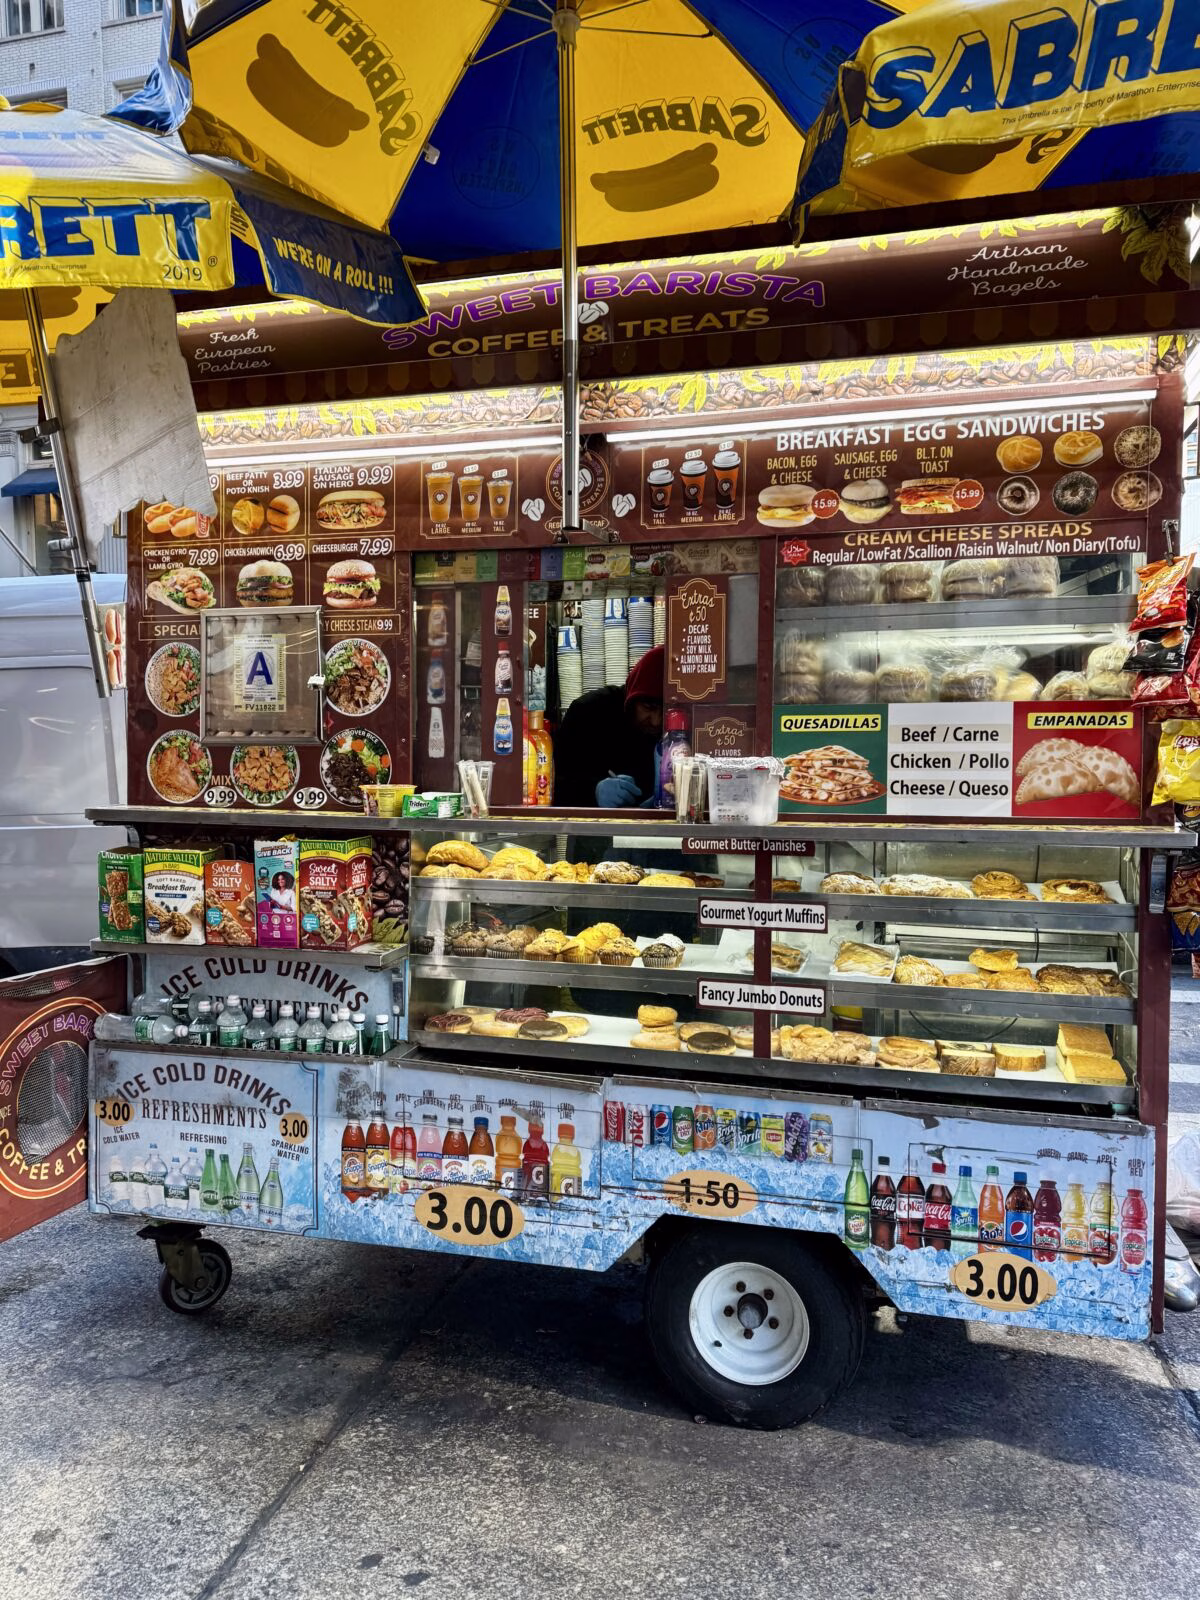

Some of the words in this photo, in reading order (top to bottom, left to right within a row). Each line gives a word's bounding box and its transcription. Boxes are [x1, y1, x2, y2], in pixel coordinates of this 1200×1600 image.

[966, 242, 1068, 262] Artisan
[272, 236, 314, 270] WE'RE
[316, 255, 331, 275] ON
[334, 261, 342, 282] A
[346, 266, 376, 292] ROLL
[947, 255, 1089, 281] Handmade
[163, 264, 202, 282] 2019
[971, 277, 1062, 297] Bagels
[382, 281, 564, 350] SWEET
[583, 270, 827, 308] BARISTA
[209, 327, 260, 344] Fresh
[427, 331, 564, 358] COFFEE
[583, 324, 608, 343] &
[618, 307, 770, 339] TREATS
[195, 344, 276, 361] European
[198, 358, 271, 374] Pastries
[776, 425, 894, 451] BREAKFAST
[903, 421, 946, 443] EGG
[956, 411, 1105, 440] SANDWICHES
[834, 451, 879, 466] SAUSAGE,
[880, 449, 898, 462] EGG
[940, 446, 954, 459] ON
[767, 457, 798, 470] BACON,
[800, 455, 817, 467] EGG
[920, 460, 949, 474] TOAST
[226, 473, 244, 481] BEEF
[245, 472, 268, 480] PATTY
[313, 472, 354, 482] SAUSAGE
[314, 466, 350, 475] ITALIAN
[357, 465, 393, 485] 9.99
[771, 472, 777, 485] &
[779, 470, 813, 484] CHEESE
[844, 468, 851, 480] &
[853, 465, 887, 479] CHEESE
[273, 470, 305, 489] 3.99
[329, 480, 354, 489] HERO
[247, 486, 270, 494] KNISH
[956, 488, 981, 500] $5.99
[814, 499, 837, 510] $5.99
[844, 530, 913, 547] CREAM
[917, 526, 993, 543] CHEESE
[998, 521, 1093, 540] SPREADS
[144, 549, 169, 557] CHICKEN
[225, 548, 246, 557] CHICKEN
[247, 547, 274, 556] SANDWICH
[274, 543, 306, 561] 6.99
[312, 543, 358, 553] CHEESEBURGER
[360, 538, 393, 556] 7.99
[812, 550, 854, 566] Regular
[1045, 539, 1071, 552] Non
[188, 548, 219, 566] 7.99
[681, 588, 715, 610] Extras
[154, 624, 200, 636] SPECIA
[688, 624, 709, 634] DECAF
[687, 635, 711, 644] FLAVORS
[686, 645, 698, 654] SOY
[699, 644, 711, 654] MILK
[680, 655, 702, 664] ALMOND
[704, 654, 717, 663] MILK
[246, 651, 273, 685] A
[682, 664, 696, 674] WHIP
[697, 664, 716, 673] CREAM
[782, 717, 880, 730] QUESADILLAS
[1034, 715, 1129, 727] EMPANADAS
[708, 724, 745, 737] Extras
[901, 726, 936, 742] Beef
[943, 726, 950, 743] /
[953, 726, 999, 742] Carne
[890, 753, 951, 770] Chicken
[959, 754, 966, 770] /
[969, 753, 1009, 770] Pollo
[211, 775, 231, 786] MIX
[207, 790, 235, 803] 9.99
[890, 780, 945, 796] Cheese
[949, 781, 956, 797] /
[959, 781, 1009, 798] Queso
[296, 791, 326, 805] 9.99
[687, 837, 729, 850] Gourmet
[730, 838, 761, 851] Butter
[762, 839, 806, 852] Danishes
[145, 852, 171, 863] NATURE
[171, 853, 199, 866] VALLEY
[147, 883, 179, 891] Breakfast
[180, 884, 196, 892] Bars
[212, 878, 242, 888] SALTY
[309, 876, 338, 887] SALTY
[701, 904, 745, 921] Gourmet
[747, 906, 783, 925] Yogurt
[785, 907, 825, 925] Muffins
[160, 965, 204, 998] ICE
[277, 958, 369, 1013] DRINKS
[701, 986, 734, 1004] Fancy
[737, 988, 776, 1005] Jumbo
[779, 990, 823, 1008] Donuts
[116, 1073, 151, 1100] ICE
[152, 1062, 206, 1086] COLD
[213, 1064, 291, 1117] DRINKS
[99, 1100, 131, 1122] 3.00
[141, 1098, 268, 1129] REFRESHMENTS
[113, 1126, 124, 1134] ICE
[280, 1118, 308, 1139] 3.00
[102, 1135, 118, 1145] COLD
[119, 1132, 140, 1143] WATER
[179, 1132, 228, 1145] REFRESHING
[271, 1139, 309, 1156] SPARKLING
[277, 1149, 300, 1162] WATER
[1096, 1155, 1118, 1167] APPLE
[55, 1158, 65, 1176] &
[1128, 1159, 1146, 1170] RUBY
[531, 1166, 544, 1185] G
[1130, 1168, 1143, 1177] RED
[680, 1177, 740, 1209] 1.50
[426, 1191, 513, 1239] 3.00
[965, 1258, 1039, 1305] 3.00
